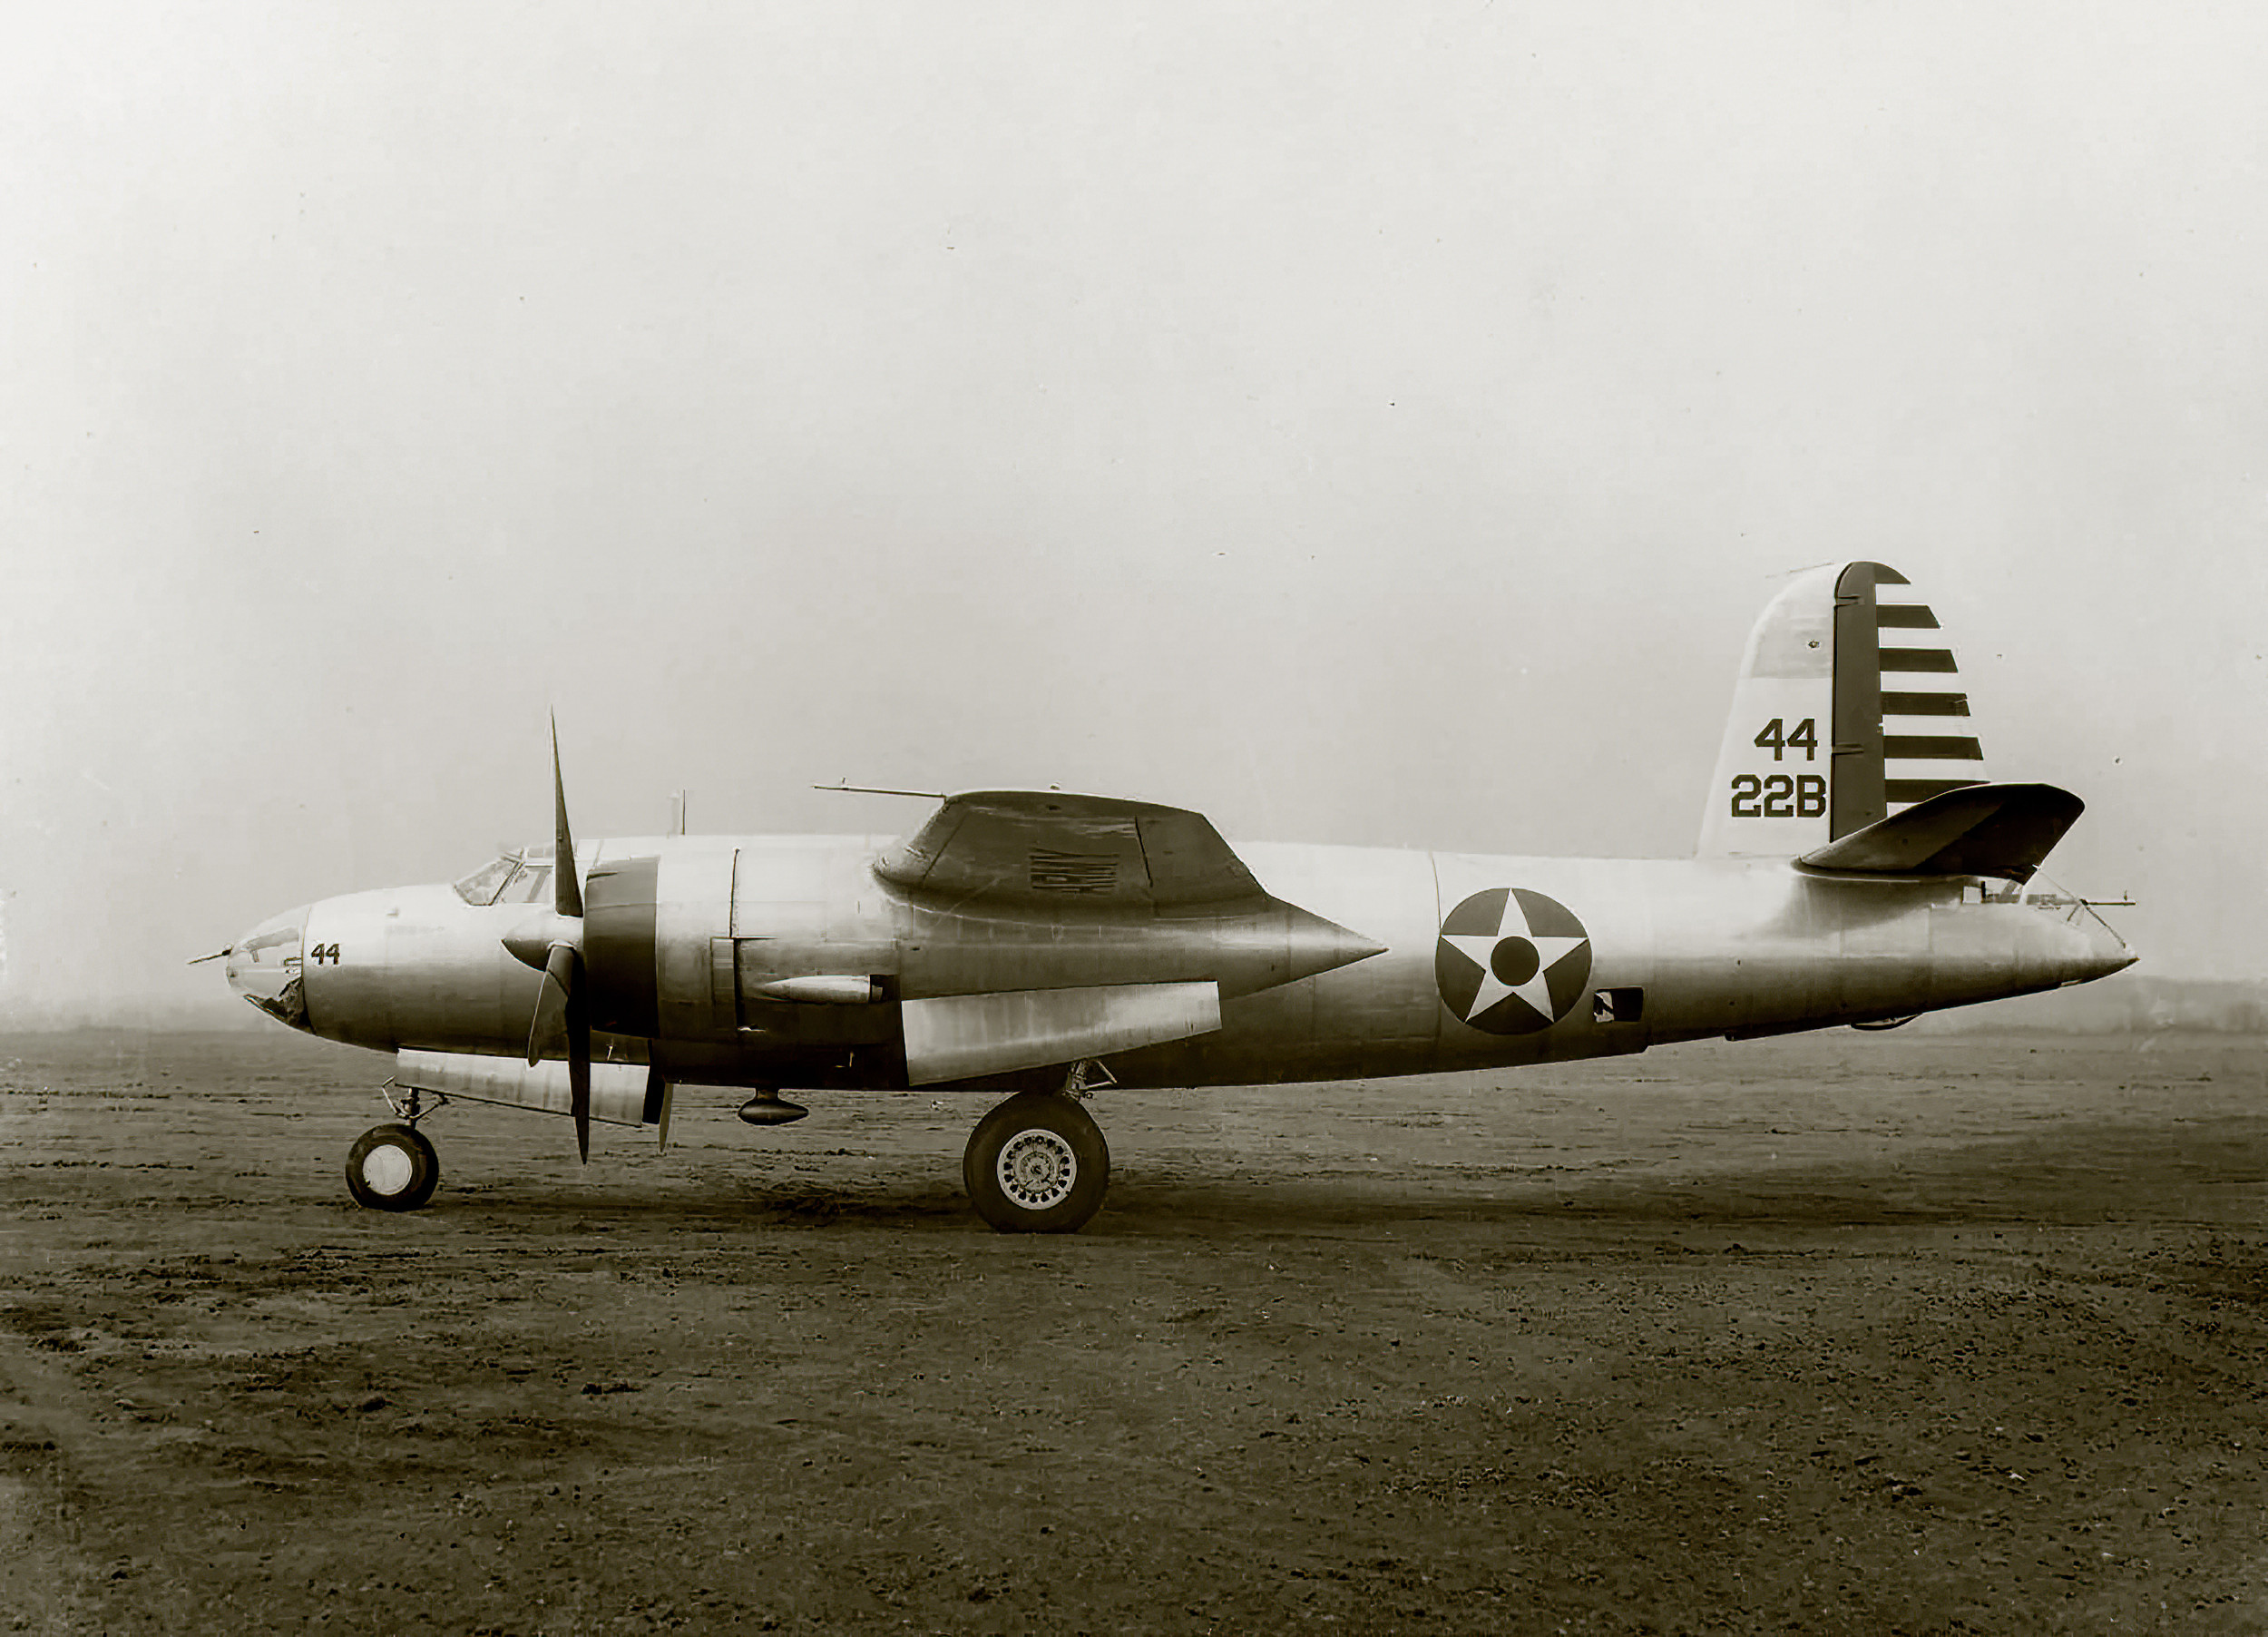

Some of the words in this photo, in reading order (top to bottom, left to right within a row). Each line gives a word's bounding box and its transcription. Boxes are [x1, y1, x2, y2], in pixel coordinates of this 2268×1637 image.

[1754, 718, 1818, 761] 44
[1731, 774, 1828, 818] 22B
[309, 943, 341, 966] 44
